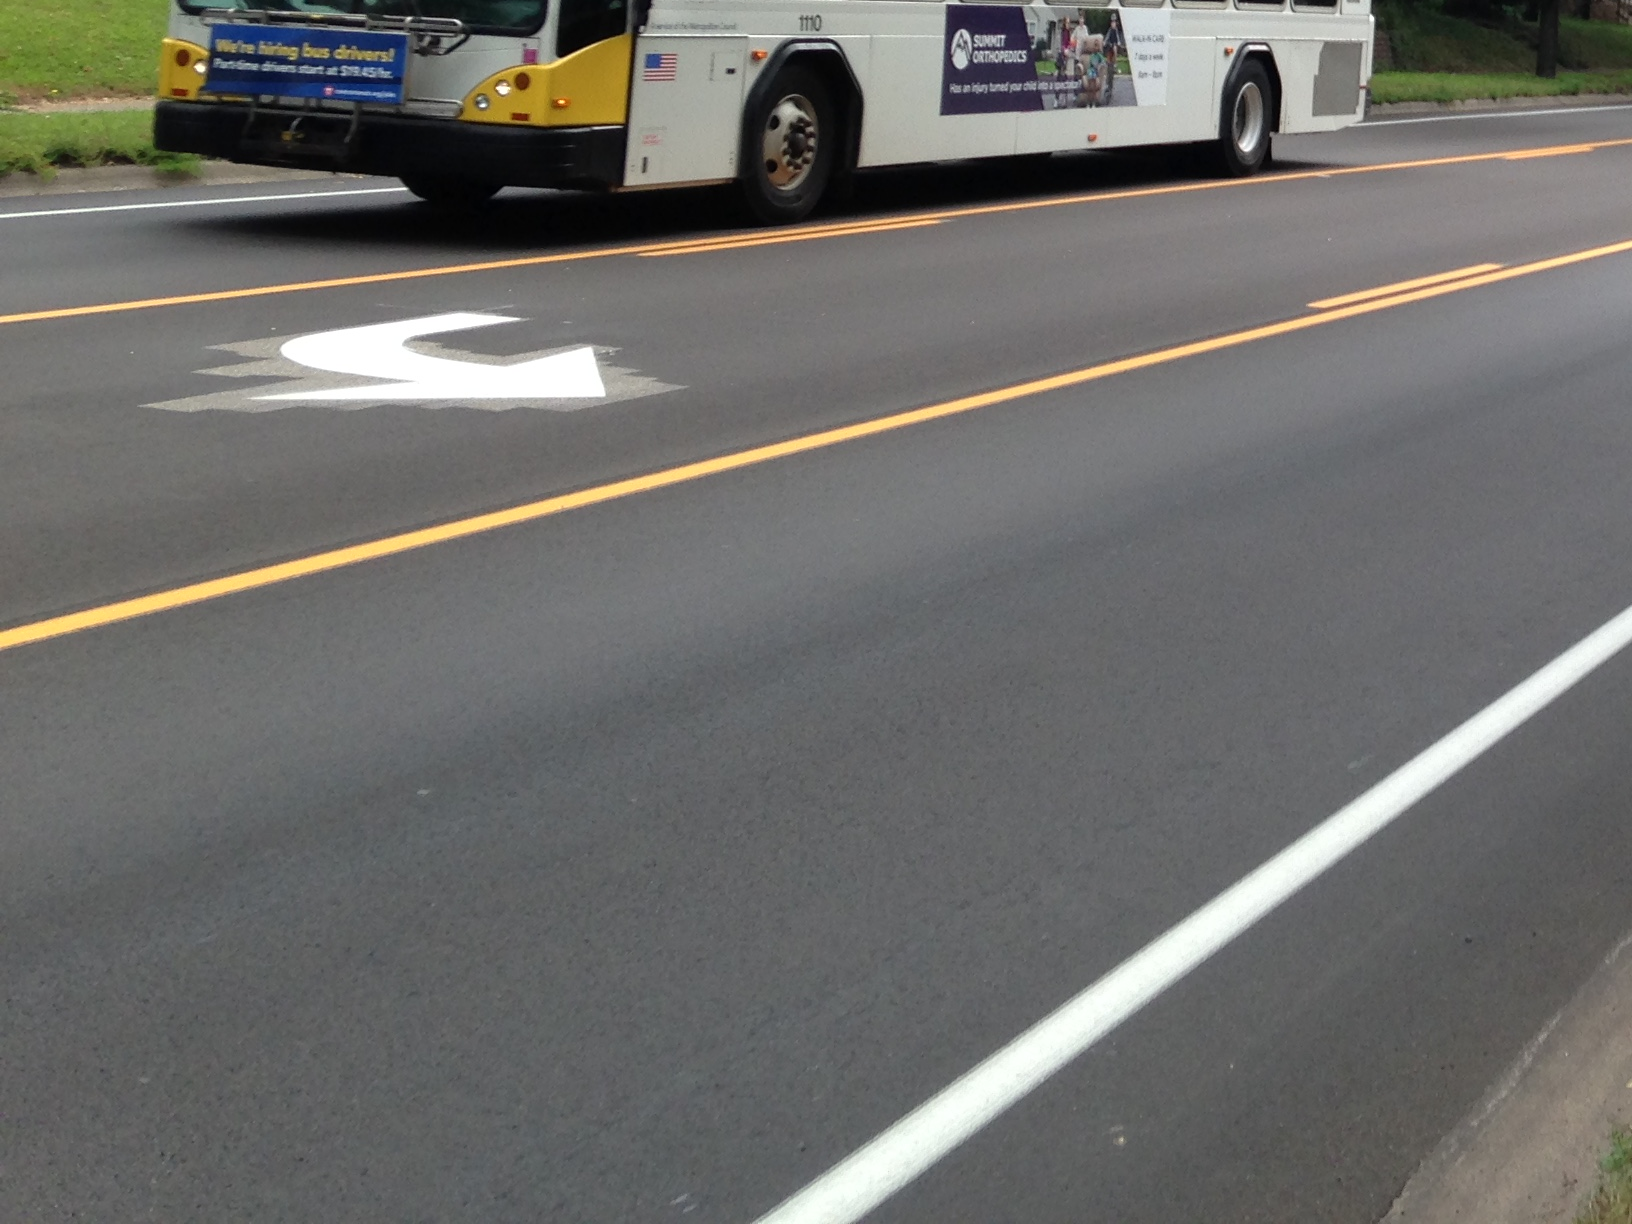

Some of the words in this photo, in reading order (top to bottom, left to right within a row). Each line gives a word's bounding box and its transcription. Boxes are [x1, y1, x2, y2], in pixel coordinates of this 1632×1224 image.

[799, 14, 822, 32] 1110
[973, 34, 1006, 48] SUMMIT
[215, 38, 255, 54] We're
[258, 40, 299, 61] hiring
[302, 42, 330, 59] bus
[333, 44, 395, 63] drivers!
[972, 50, 1028, 64] ORTHOPEDICS
[261, 60, 296, 73] drivers
[298, 64, 325, 75] start
[949, 83, 962, 94] Has
[962, 84, 971, 93] an
[971, 82, 989, 95] injury
[989, 82, 1009, 92] turned
[1009, 83, 1022, 93] your
[1023, 80, 1038, 91] child
[1038, 80, 1049, 90] into
